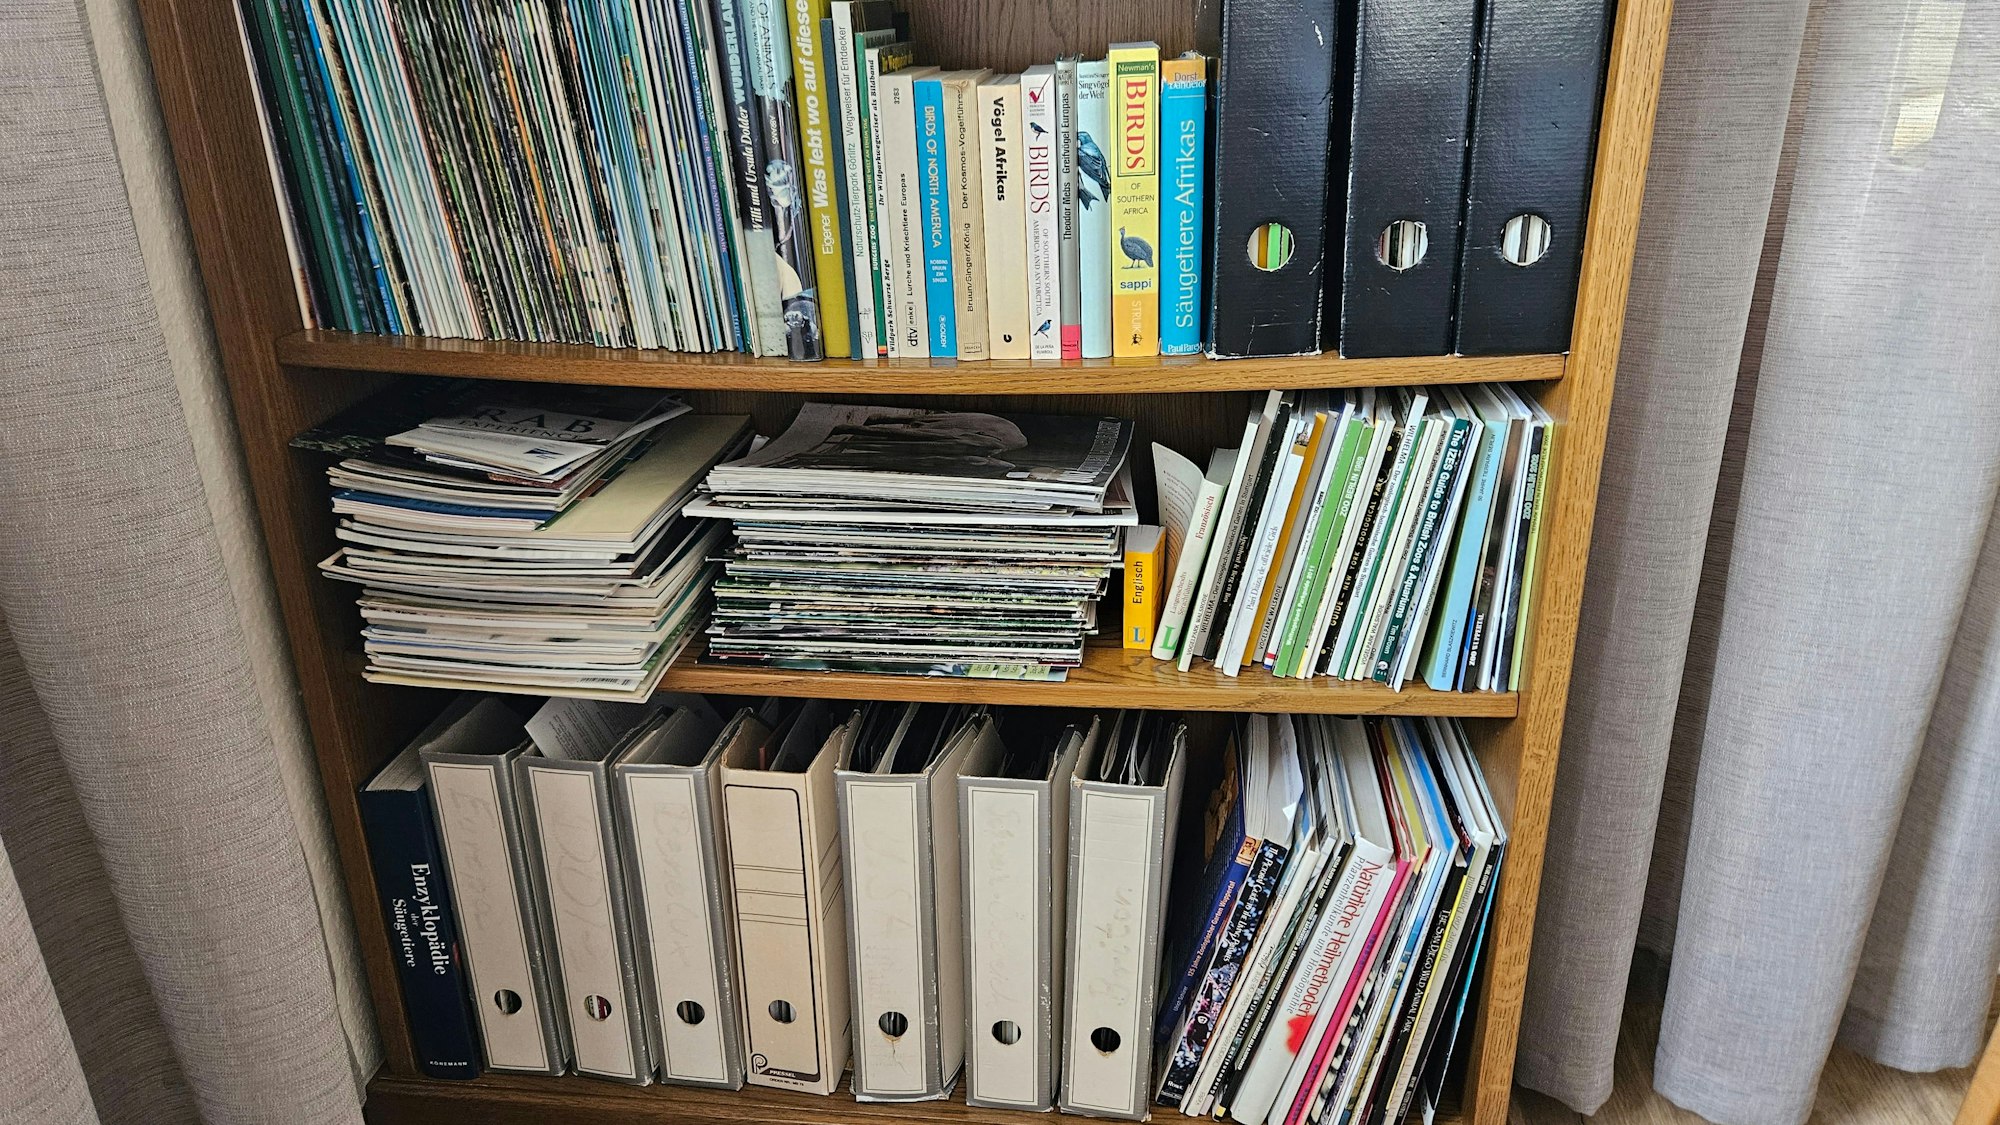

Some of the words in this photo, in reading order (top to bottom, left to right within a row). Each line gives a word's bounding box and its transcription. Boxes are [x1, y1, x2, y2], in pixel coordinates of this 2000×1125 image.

[793, 0, 813, 57] diese
[759, 24, 778, 90] ANIMALS
[836, 25, 849, 70] Entdecker
[799, 58, 816, 92] auf
[840, 72, 850, 85] für
[867, 60, 876, 96] Bildband
[1118, 64, 1155, 72] Newman's
[1174, 72, 1198, 82] Dorst
[1078, 80, 1109, 90] Singvögel
[1078, 92, 1089, 100] der
[1089, 91, 1105, 99] Welt
[805, 94, 820, 125] wo
[841, 87, 855, 136] Wegweiser
[923, 106, 935, 136] BIRDS
[991, 97, 1005, 141] Vögel
[1062, 93, 1070, 128] Europas
[1126, 80, 1148, 170] BIRDS
[736, 106, 752, 146] Dolder
[769, 115, 779, 144] ABRAMS
[805, 127, 824, 167] lebt
[846, 143, 857, 170] Görlitz
[871, 113, 884, 191] Wildparkwegweiser
[925, 138, 937, 155] OF
[1062, 130, 1071, 174] Greifvögel
[741, 145, 757, 183] Ursula
[927, 158, 939, 195] NORTH
[995, 147, 1008, 201] Afrikas
[1174, 119, 1196, 208] Afrikas
[748, 185, 760, 206] und
[810, 168, 829, 208] Was
[898, 173, 908, 206] Europas
[1029, 146, 1050, 214] BIRDS
[1062, 182, 1070, 205] Mebs
[849, 172, 865, 256] Naturschutz-Tierpark
[961, 191, 969, 208] Der
[1117, 194, 1155, 204] SOUTHERN
[1123, 207, 1148, 215] AFRICA
[749, 206, 764, 233] Willi
[818, 213, 836, 255] Eigener
[901, 209, 910, 251] Kriechtiere
[929, 196, 943, 247] AMERICA
[1043, 228, 1048, 238] OF
[1063, 207, 1071, 240] Theodor
[883, 258, 891, 279] Berge
[903, 254, 911, 267] und
[1176, 210, 1198, 328] Säugetiere
[904, 270, 913, 295] Lurche
[1034, 271, 1042, 316] ANTARCTICA
[1120, 279, 1152, 291] sappi
[885, 282, 894, 317] Schwarze
[907, 306, 915, 324] enke
[1132, 300, 1142, 334] STRUIK
[887, 319, 896, 351] Wildpark
[906, 327, 918, 346] dtv
[939, 322, 947, 348] GOLDEN
[1397, 424, 1416, 465] WILHELMA
[1449, 427, 1464, 448] The
[1487, 434, 1496, 452] BERLIN
[1442, 447, 1457, 471] IZES
[1482, 453, 1492, 477] TIERPARK
[1530, 453, 1539, 473] 2002
[1391, 469, 1401, 481] Der
[1433, 471, 1450, 499] Guide
[1478, 478, 1487, 495] JAHRE
[1524, 473, 1537, 501] BERLIN
[1338, 499, 1351, 517] ZOO
[1345, 472, 1360, 500] BERLIN
[1400, 549, 1408, 560] Zoo
[1404, 538, 1412, 549] und
[1425, 459, 1437, 484] Oberwald
[1429, 498, 1441, 511] to
[1193, 494, 1215, 539] Französisch
[1370, 481, 1397, 547] zoologisch-botanische
[1419, 511, 1437, 541] British
[1522, 501, 1533, 520] ZOO
[1329, 599, 1343, 626] GUIDE
[1342, 574, 1352, 590] NEW
[1349, 550, 1360, 570] YORK
[1356, 500, 1376, 546] ZOOLOGICAL
[1372, 476, 1384, 496] PARK
[1364, 547, 1375, 567] Garten
[1412, 540, 1428, 565] Zoos
[1132, 560, 1144, 605] Englisch
[1245, 595, 1257, 610] Pairi
[1255, 565, 1265, 575] de
[1265, 524, 1278, 541] Gids
[1409, 564, 1420, 573] &
[1297, 579, 1311, 608] Parkguide
[1306, 564, 1315, 579] 2011
[1353, 573, 1367, 599] Stuttgart
[1393, 572, 1417, 620] Aquariums
[1201, 599, 1216, 633] WILHELMA
[1257, 616, 1273, 650] VOGELPARK
[1268, 584, 1282, 616] WALSRODE
[1389, 623, 1398, 635] Tim
[1471, 612, 1484, 650] WUPPERTAL
[1360, 634, 1374, 665] VOGELPARK
[1370, 603, 1384, 634] WALSRODE
[1383, 635, 1395, 654] Brown
[1441, 652, 1451, 677] BERNHARD
[1468, 650, 1477, 666] ZOO
[1218, 880, 1237, 908] Wuppertal
[1324, 856, 1365, 937] Pflanzenheilkunde
[1337, 860, 1382, 928] Natürliche
[1456, 875, 1477, 914] Dortmund
[410, 862, 450, 976] Enzyklopädie
[410, 912, 419, 927] der
[1210, 906, 1224, 925] Garten
[1451, 914, 1463, 930] Zoo
[392, 898, 416, 968] Säugetiere
[1196, 923, 1218, 956] Zoologischer
[1312, 938, 1325, 956] und
[1443, 931, 1457, 952] Jahre
[1187, 967, 1196, 977] 125
[1191, 953, 1203, 968] Jahre
[1296, 930, 1350, 1017] Heilmethoden
[1289, 956, 1318, 1014] Homöopathie
[770, 1070, 796, 1078] PRESSEL
